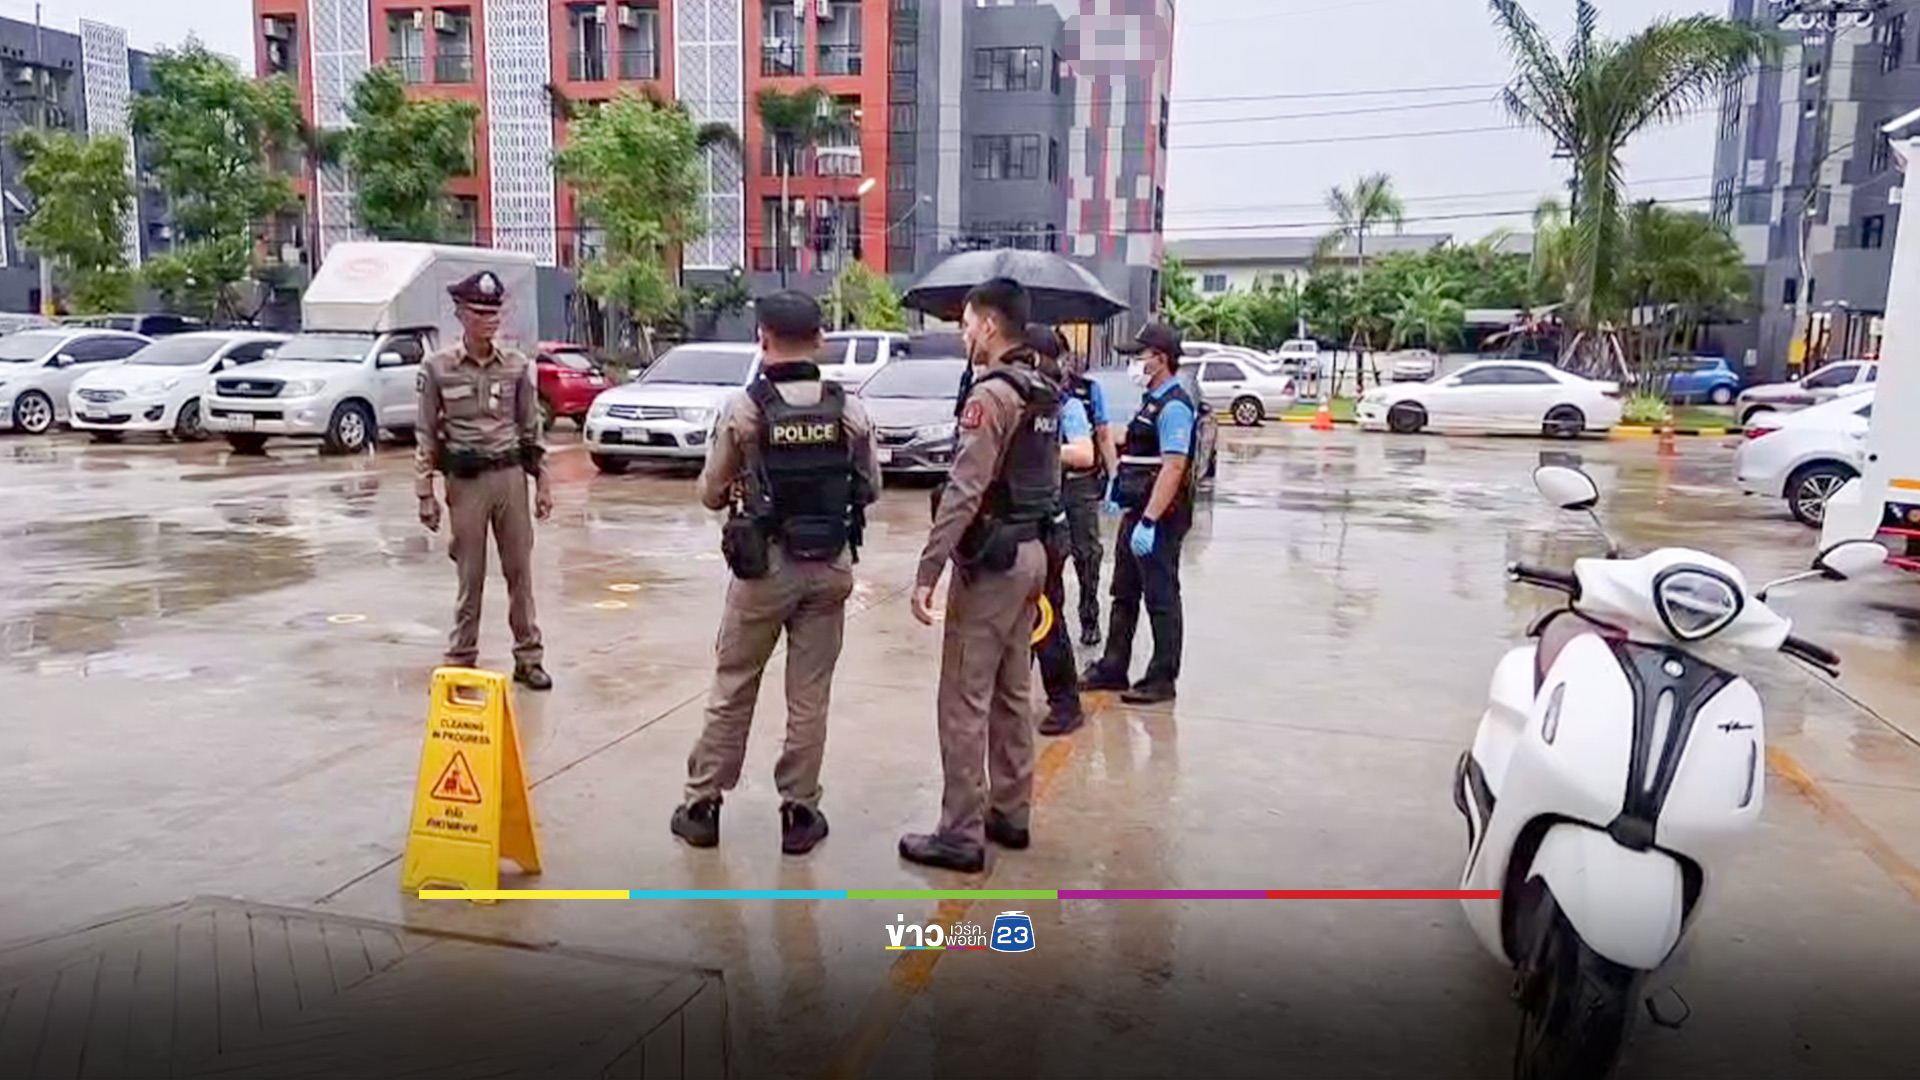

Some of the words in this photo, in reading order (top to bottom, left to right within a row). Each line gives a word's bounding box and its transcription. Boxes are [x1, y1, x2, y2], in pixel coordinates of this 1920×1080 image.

[774, 424, 834, 441] POLICE
[440, 718, 484, 732] CLEANING
[432, 731, 441, 739] IN
[442, 731, 491, 744] PROGRESS
